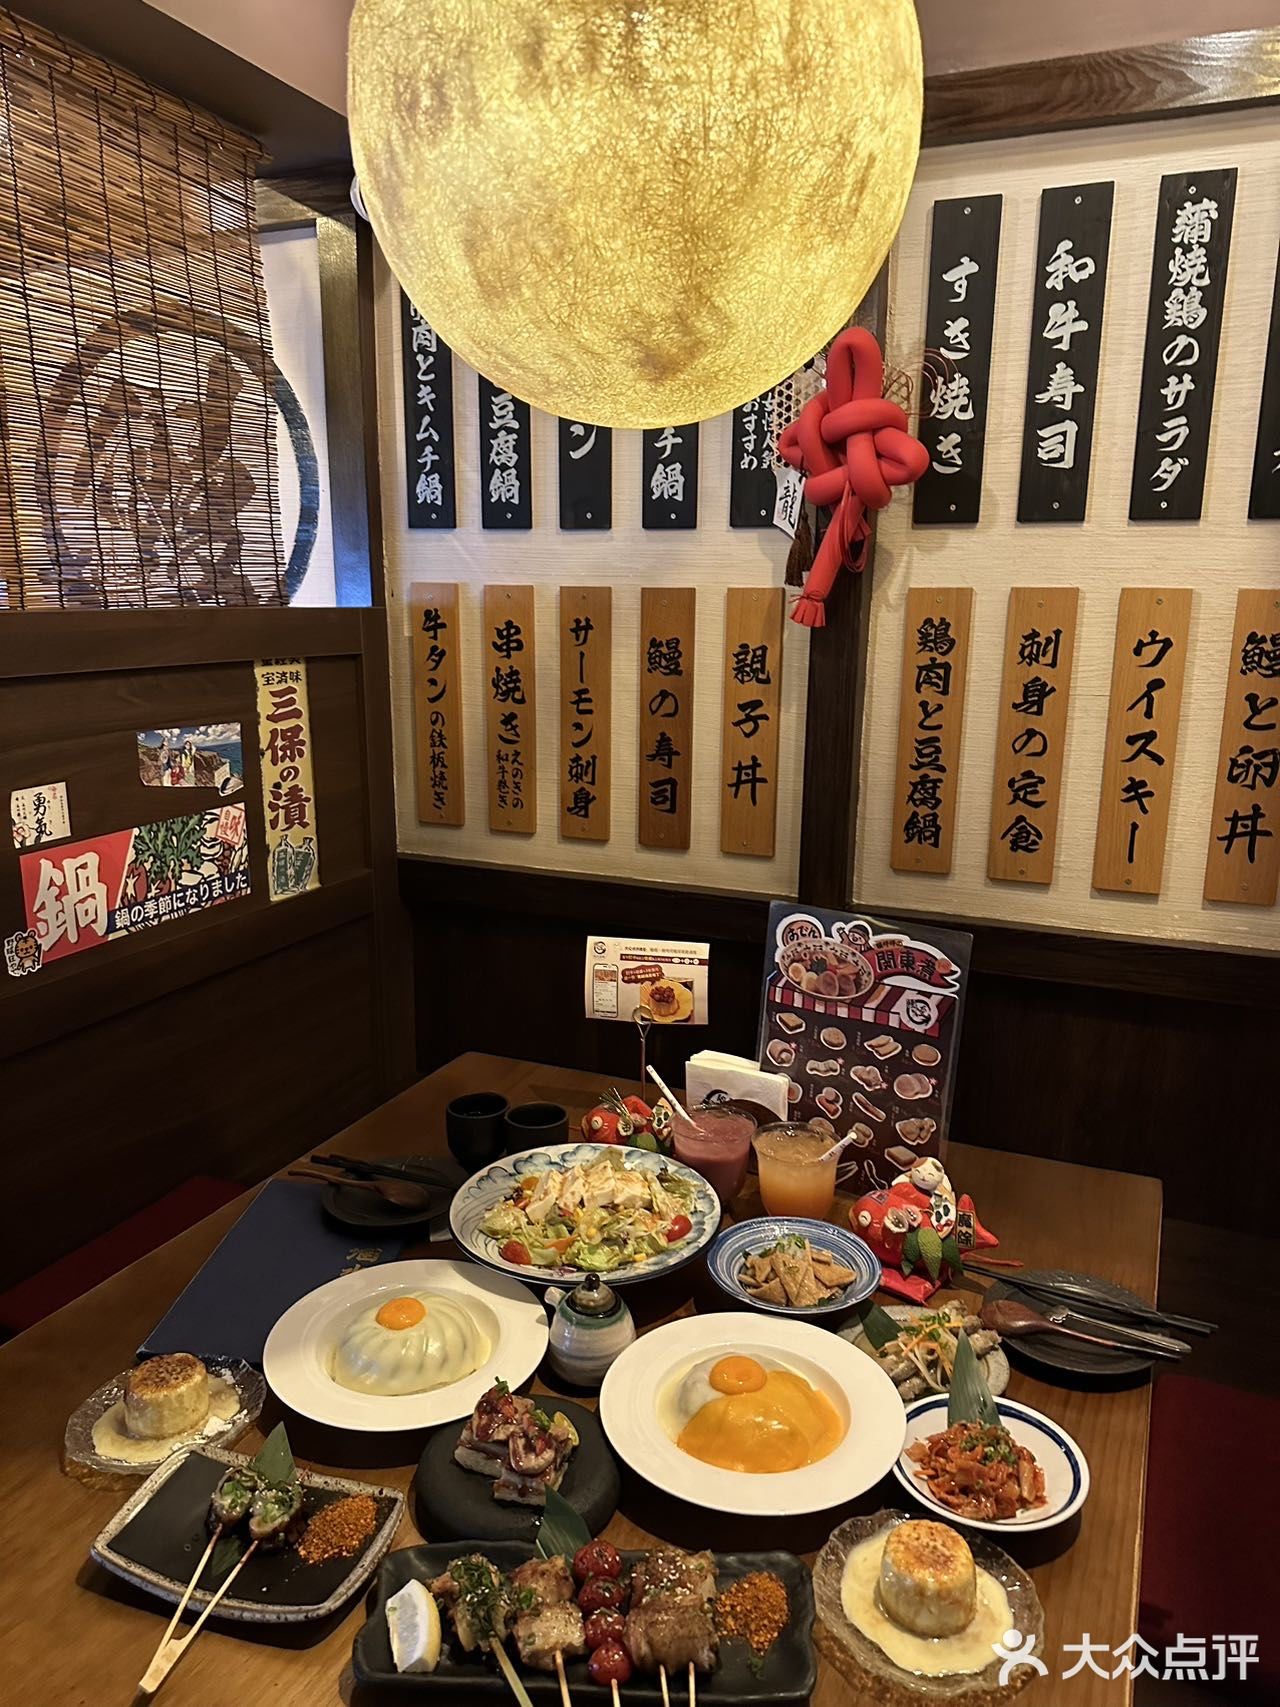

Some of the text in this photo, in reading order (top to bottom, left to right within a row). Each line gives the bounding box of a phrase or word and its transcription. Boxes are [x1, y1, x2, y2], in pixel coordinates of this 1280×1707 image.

[740, 397, 760, 471] おすすめ
[929, 255, 980, 475] すき焼き
[1034, 238, 1096, 470] 和牛寿司
[489, 383, 521, 505] 豆腐鍋
[650, 426, 685, 502] チ鍋
[491, 619, 527, 745] 串焼き
[566, 616, 598, 820] サーモン刺身
[645, 636, 684, 816] 鰻の寿司
[726, 642, 772, 807] 親子丼
[903, 616, 957, 849] 鶏肉と豆腐鍋
[1000, 627, 1064, 854] 刺身の定食
[1120, 629, 1174, 864] ウイスキー
[1216, 631, 1280, 864] 鰻と卵丼
[28, 850, 110, 953] 鍋
[114, 872, 248, 929] 鍋の季節になりました
[787, 926, 819, 942] おでん
